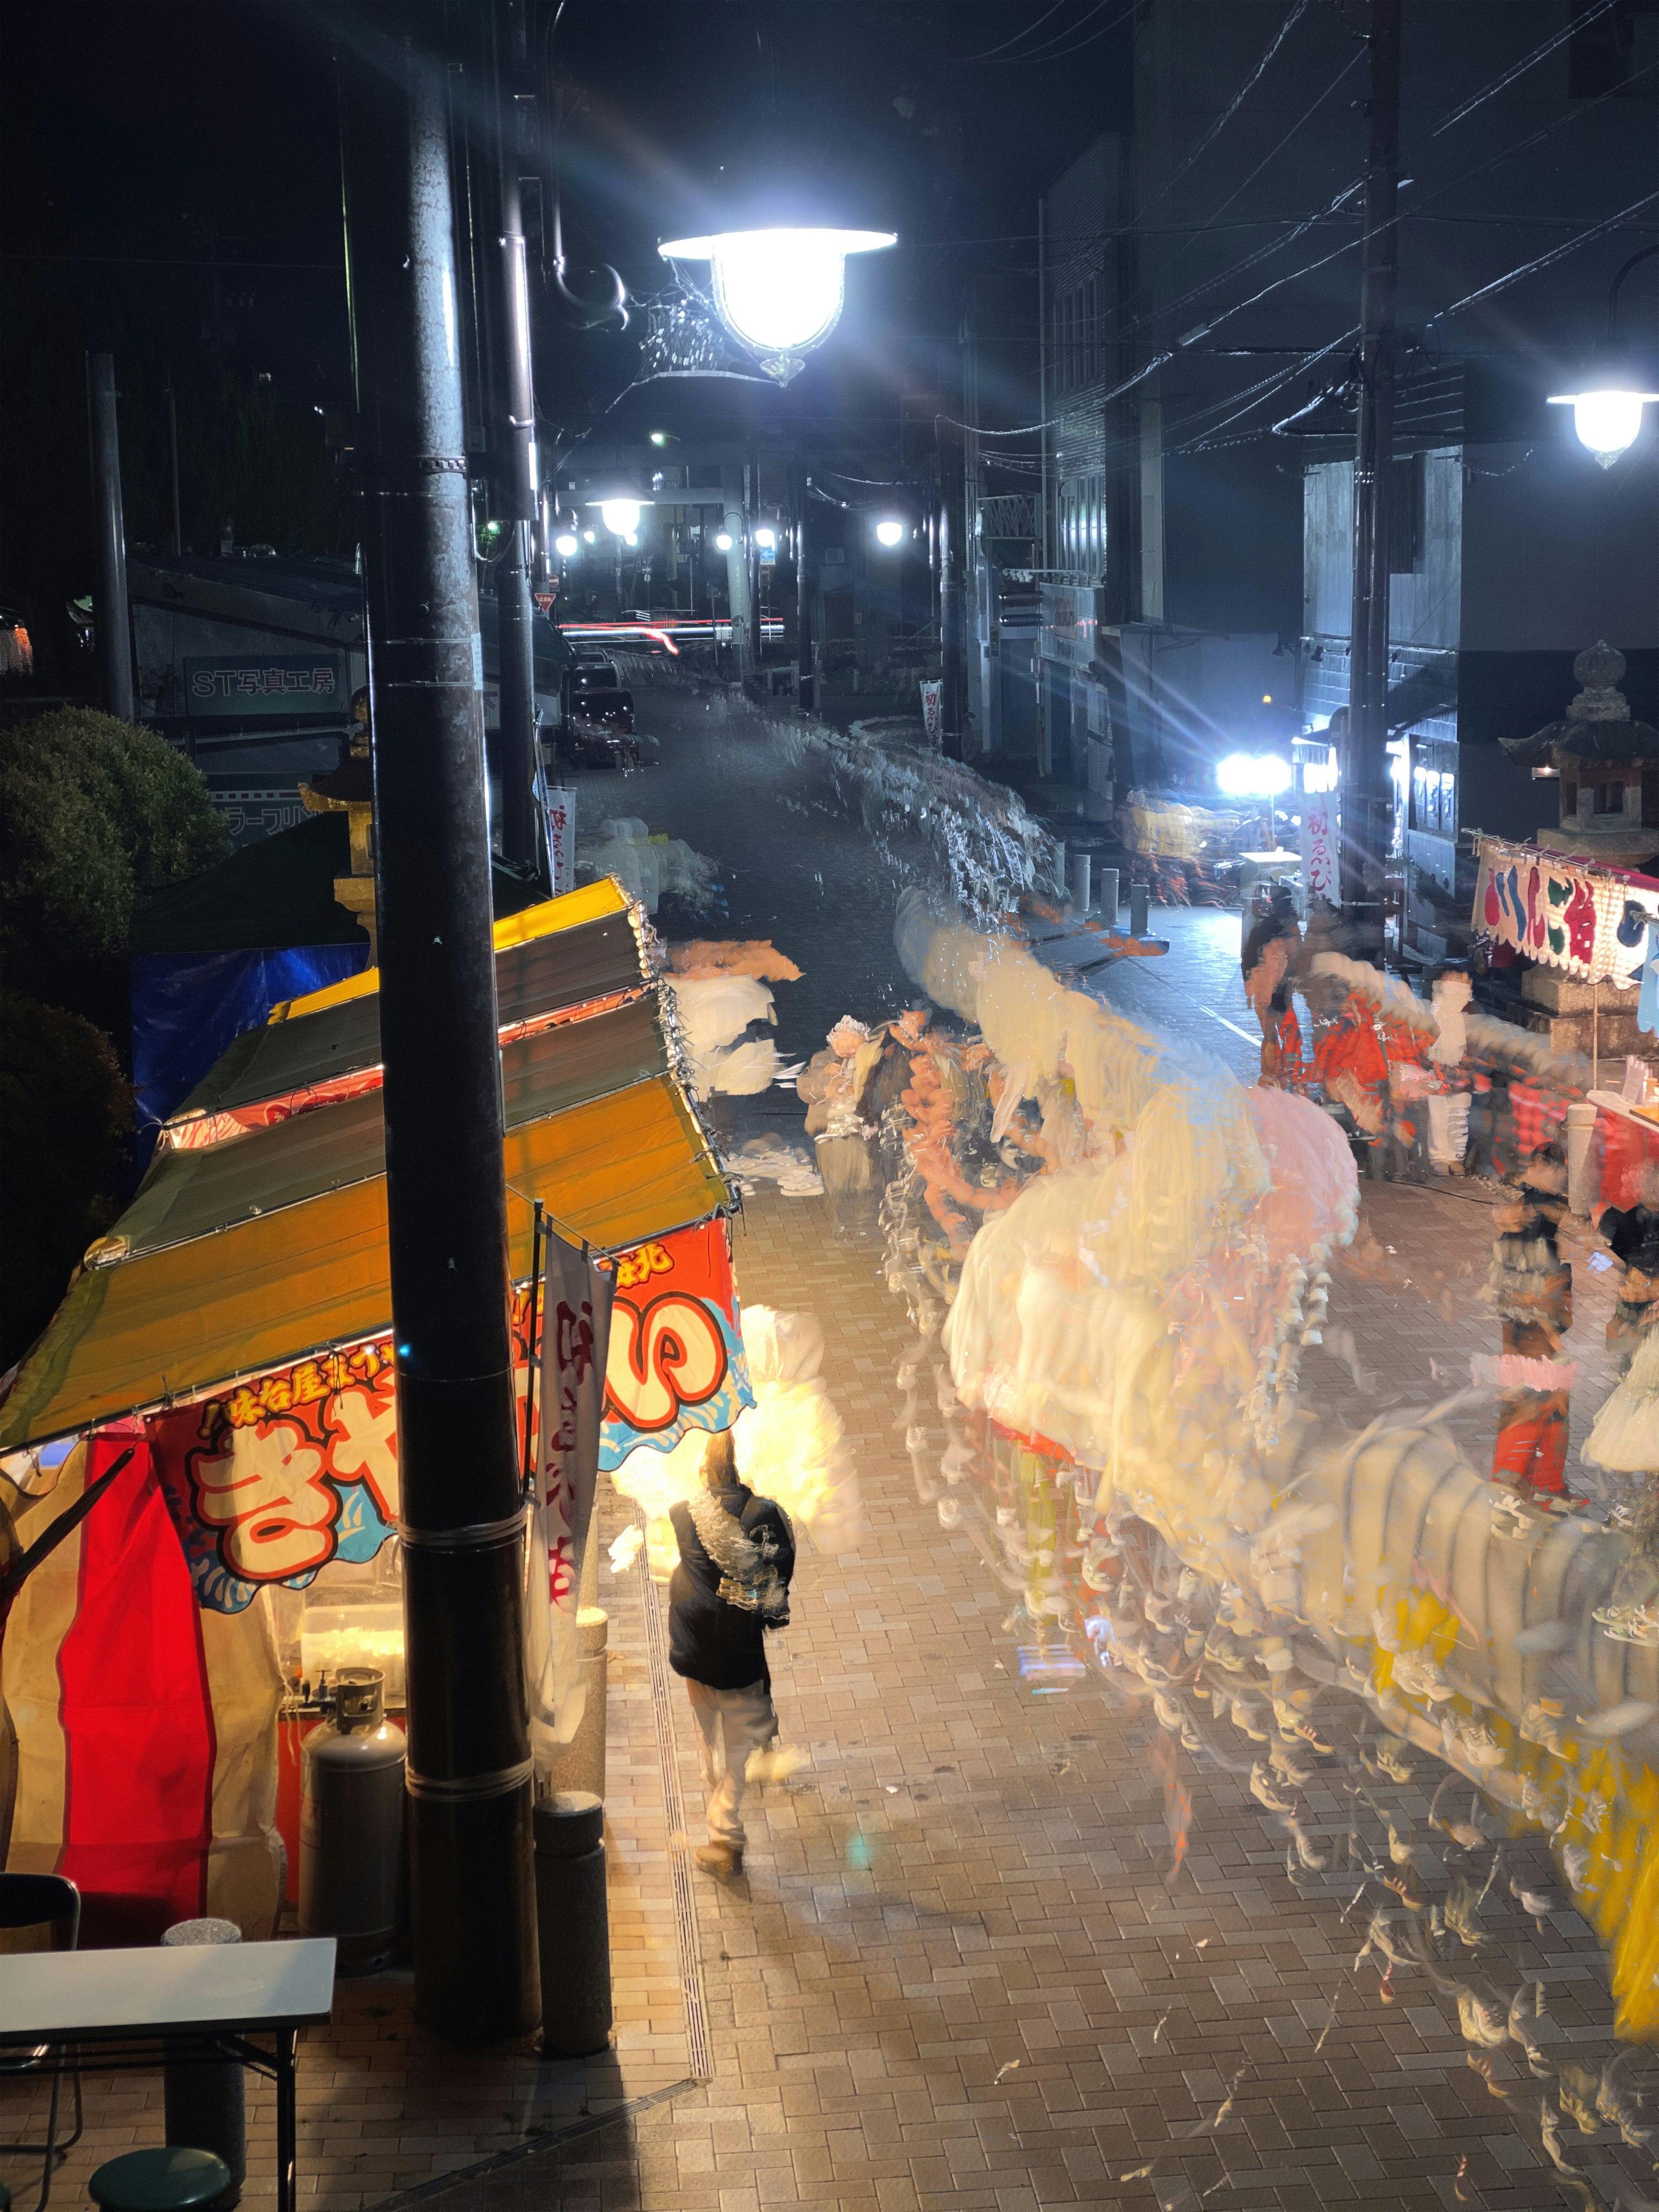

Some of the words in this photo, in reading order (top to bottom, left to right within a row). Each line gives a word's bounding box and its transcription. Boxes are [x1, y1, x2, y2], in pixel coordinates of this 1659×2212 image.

[192, 668, 335, 697] ST写真工房
[1307, 806, 1333, 896] 初ゑび
